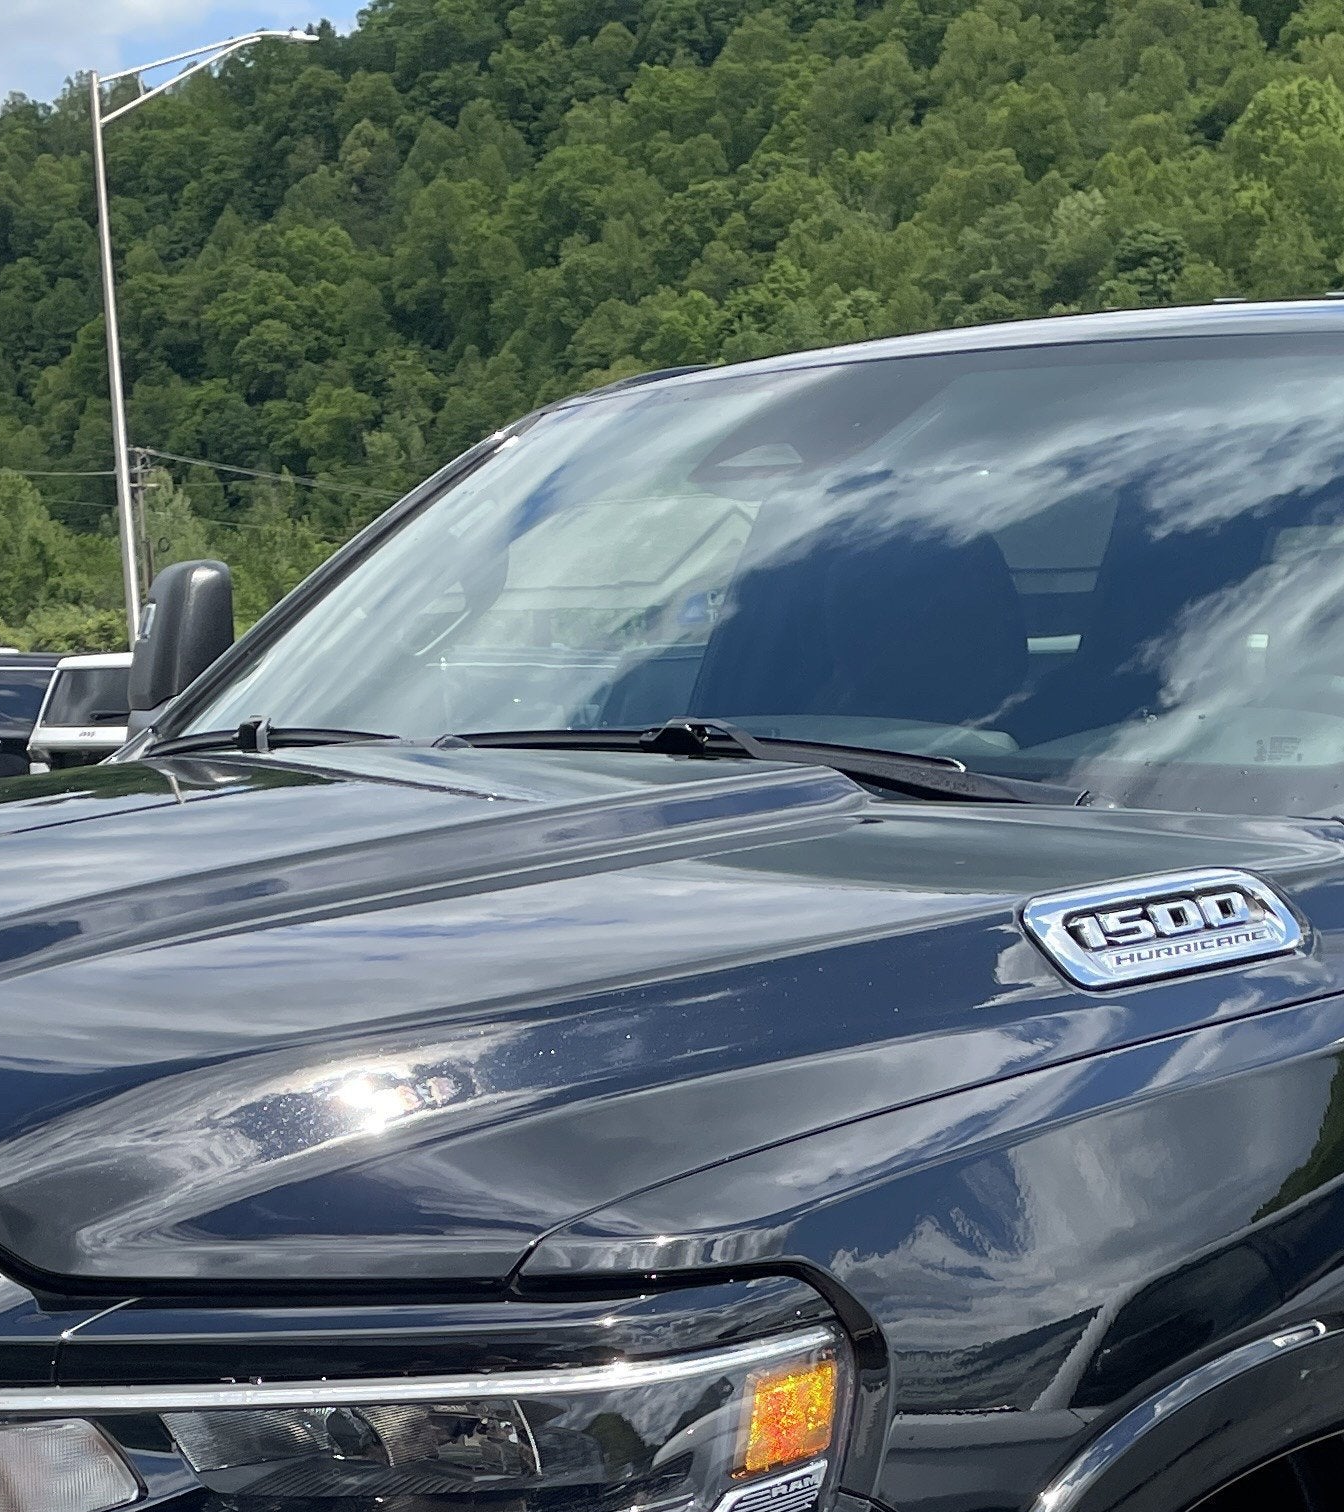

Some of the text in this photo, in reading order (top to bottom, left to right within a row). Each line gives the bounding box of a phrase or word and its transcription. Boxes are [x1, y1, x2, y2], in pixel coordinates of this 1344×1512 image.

[1065, 891, 1251, 950] 1500
[1114, 930, 1269, 966] HURRICANE
[770, 1474, 819, 1498] RAM
